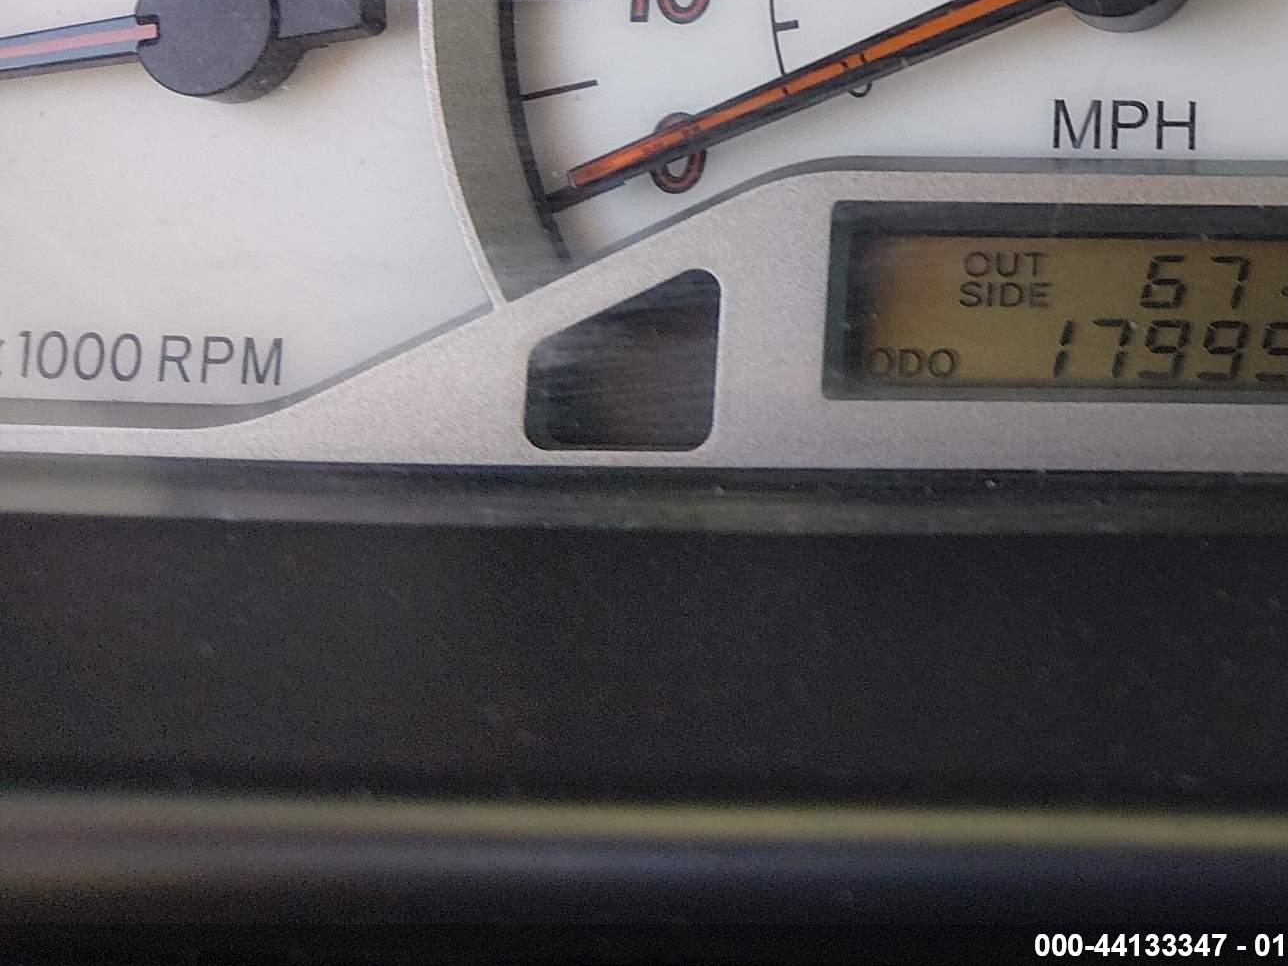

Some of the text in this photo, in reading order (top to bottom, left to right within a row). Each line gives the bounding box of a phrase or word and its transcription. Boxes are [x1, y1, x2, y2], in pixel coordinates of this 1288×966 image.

[1052, 100, 1198, 151] MPH
[963, 250, 1045, 277] OUT
[1140, 255, 1251, 310] 67
[958, 281, 1053, 309] SIDE
[19, 330, 142, 381] 1000
[157, 335, 283, 385] RPM
[866, 348, 960, 379] ODO
